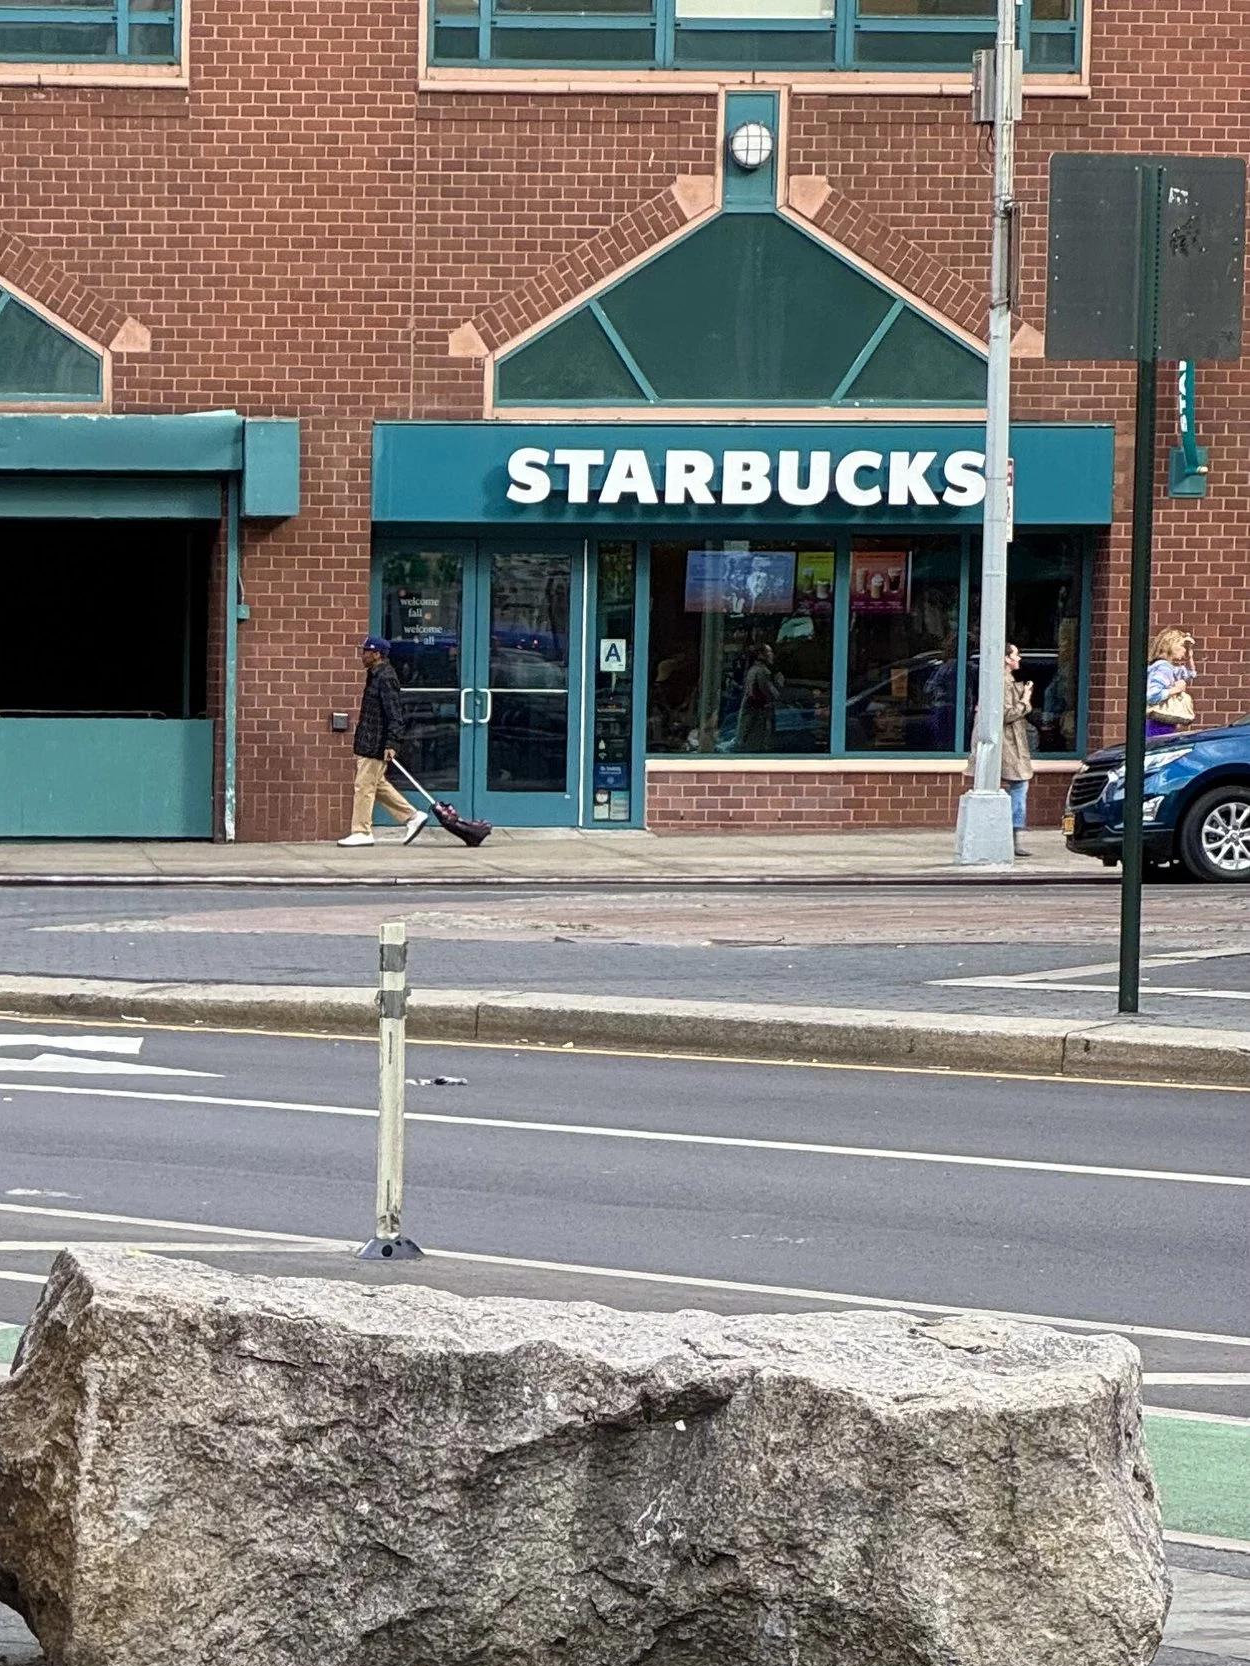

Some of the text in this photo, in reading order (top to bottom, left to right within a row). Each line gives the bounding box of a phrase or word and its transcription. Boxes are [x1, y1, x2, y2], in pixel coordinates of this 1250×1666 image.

[506, 447, 986, 507] STARBUCKS
[400, 597, 440, 606] welcome
[408, 608, 423, 617] fall
[404, 624, 443, 634] welcome
[423, 635, 435, 645] all
[605, 643, 622, 662] A
